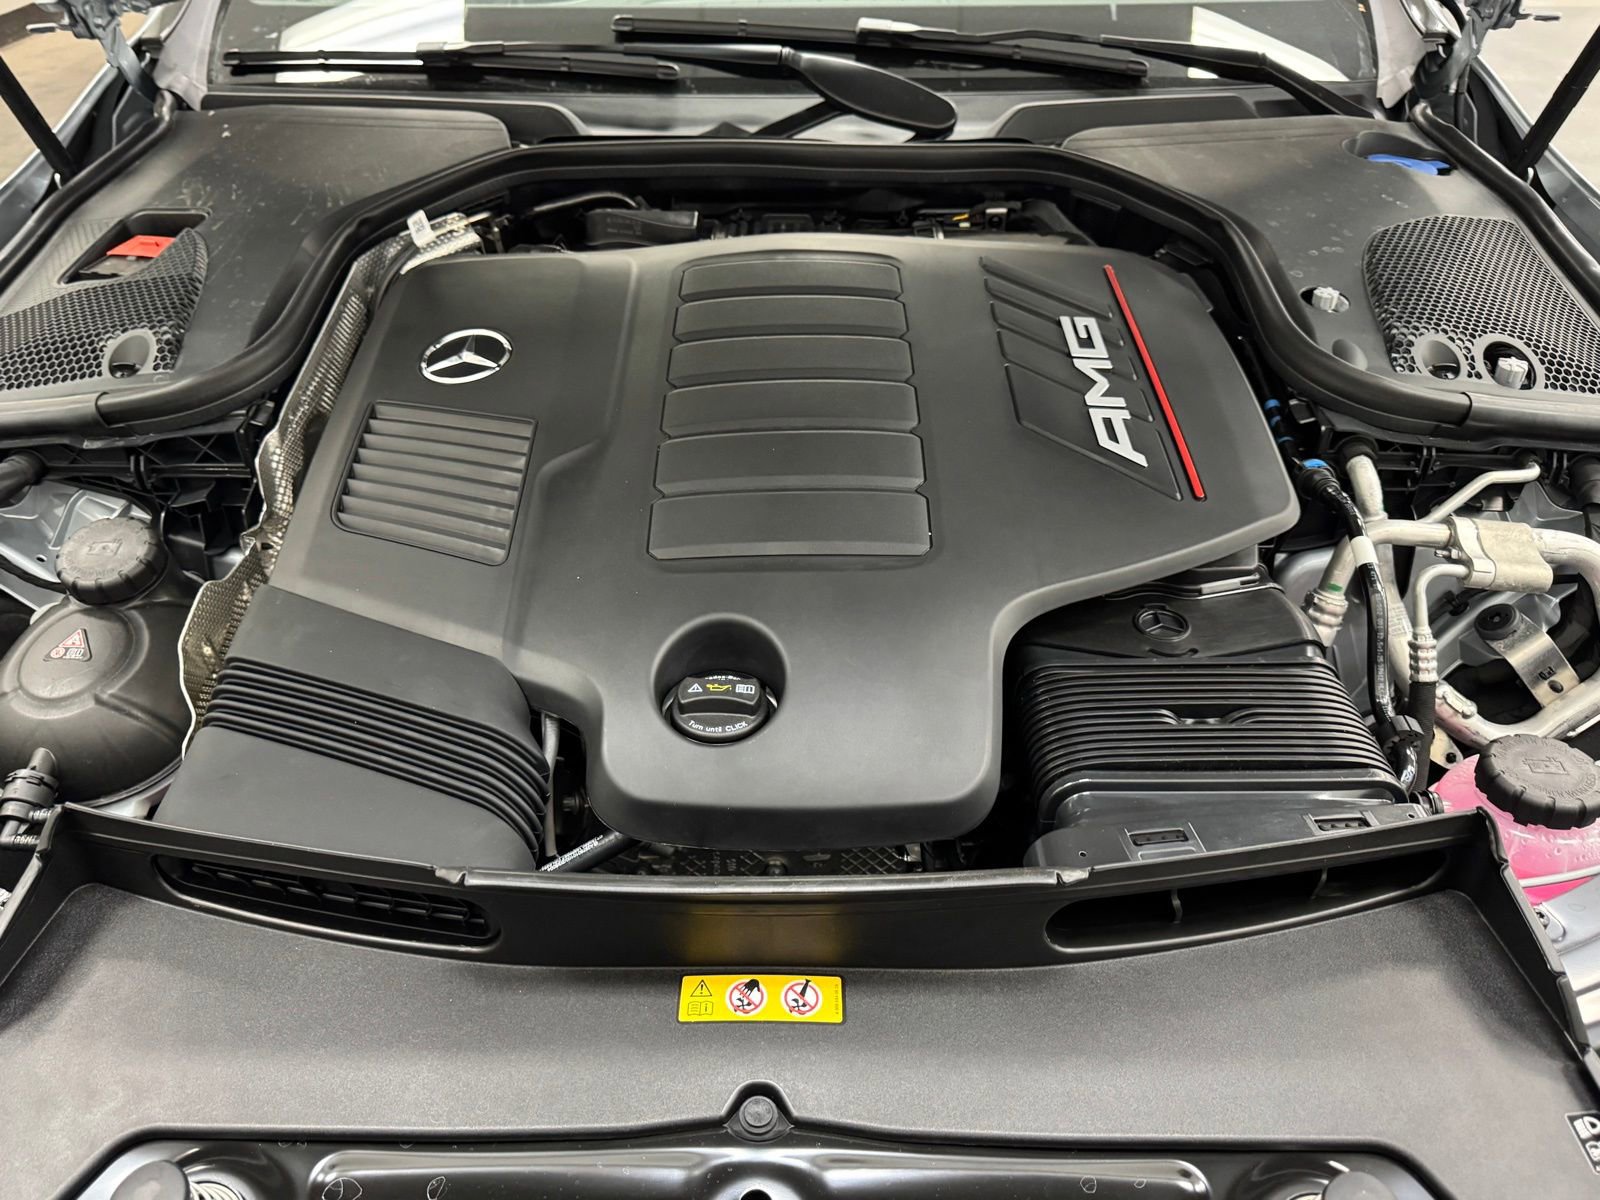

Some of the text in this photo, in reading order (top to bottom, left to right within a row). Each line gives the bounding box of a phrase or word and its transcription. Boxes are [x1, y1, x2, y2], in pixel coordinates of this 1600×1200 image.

[1059, 315, 1149, 468] AMG
[688, 720, 704, 731] Turn
[725, 720, 748, 732] CLICK
